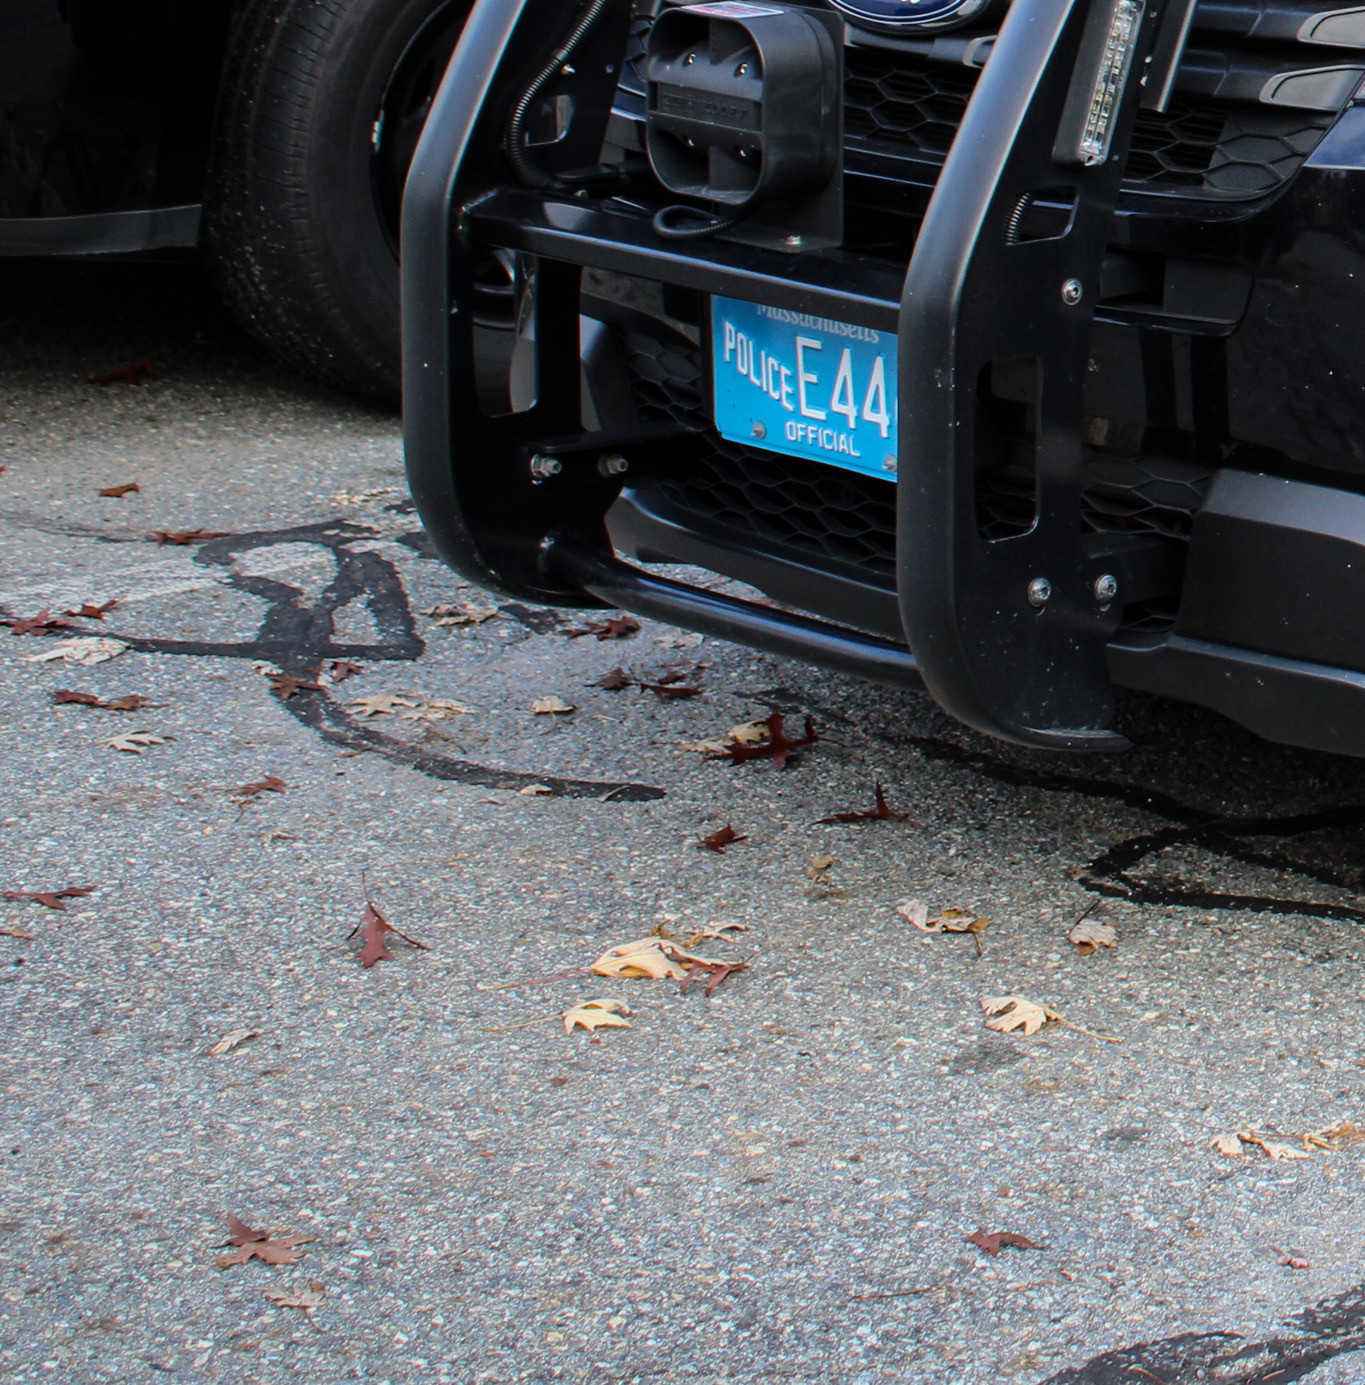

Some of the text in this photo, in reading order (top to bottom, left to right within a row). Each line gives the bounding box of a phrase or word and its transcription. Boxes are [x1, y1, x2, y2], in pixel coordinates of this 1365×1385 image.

[723, 321, 898, 438] POLICE E44
[785, 420, 861, 457] OFFICIAL
